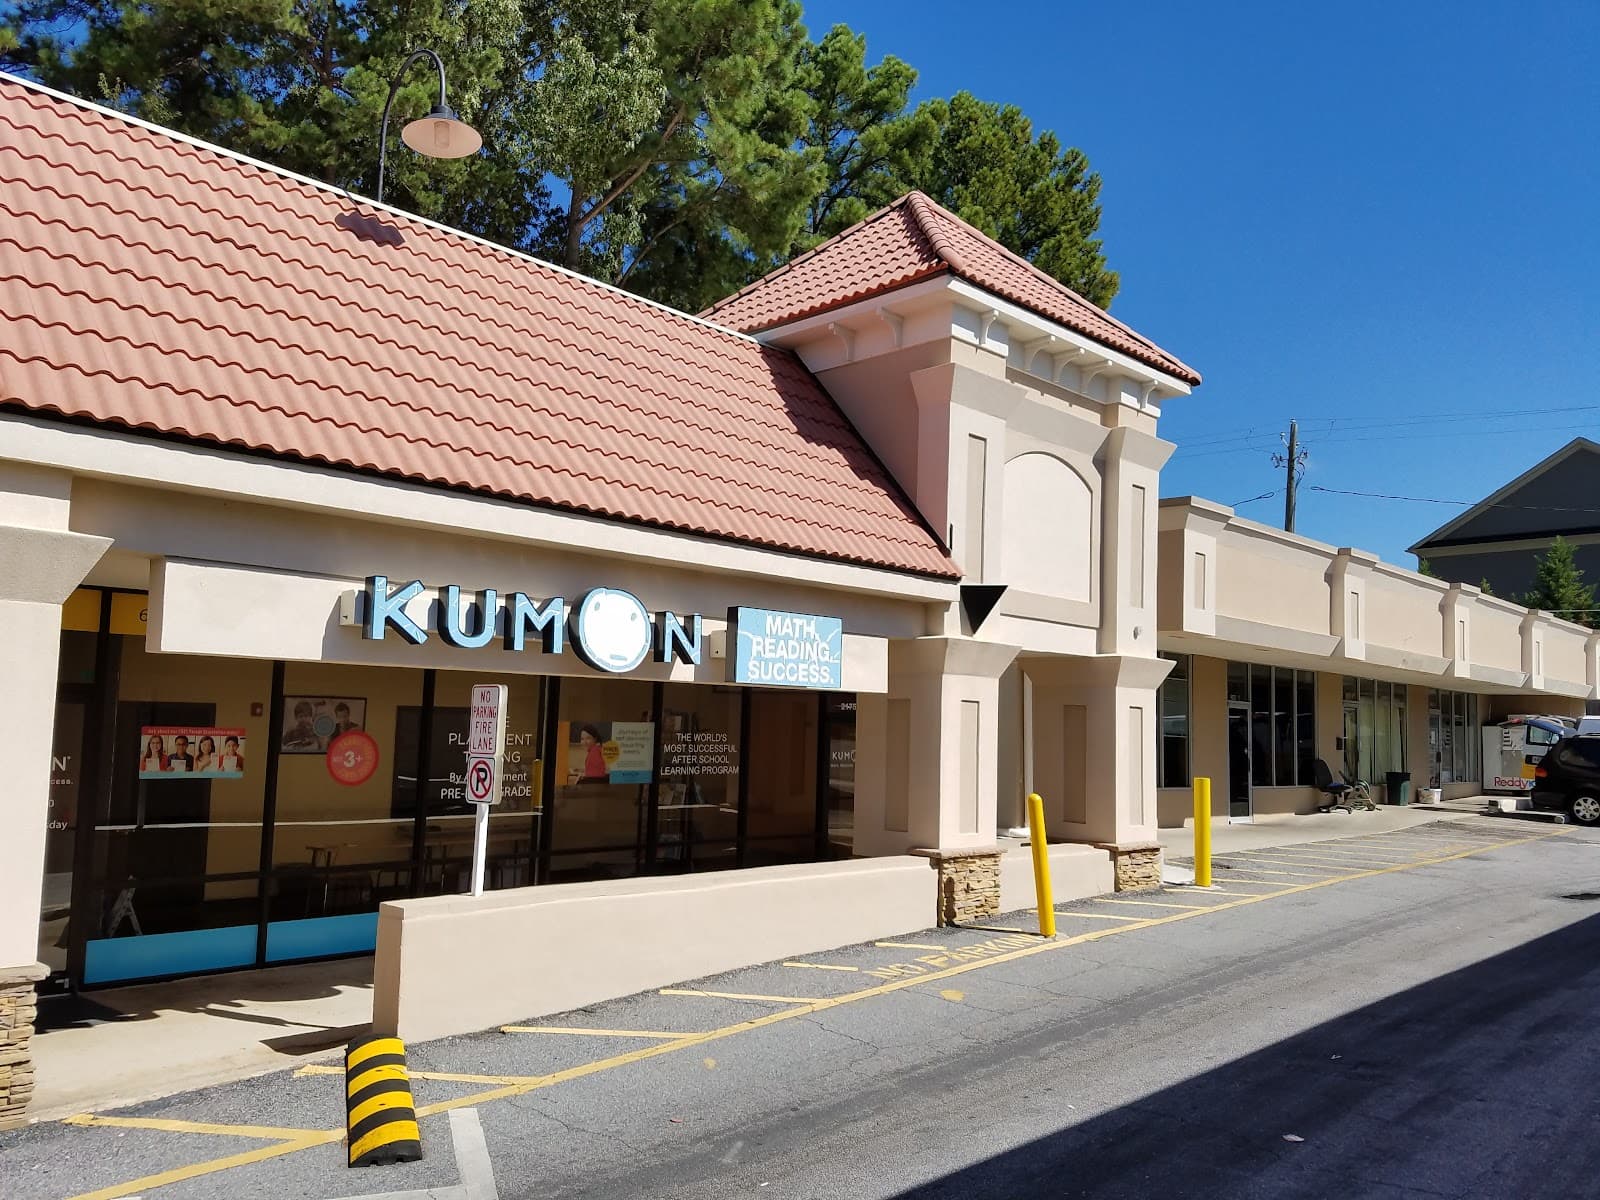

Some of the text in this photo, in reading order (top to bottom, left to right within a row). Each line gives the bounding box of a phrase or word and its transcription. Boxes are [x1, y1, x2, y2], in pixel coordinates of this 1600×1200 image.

[362, 575, 702, 673] KUMON
[480, 690, 491, 703] NO
[473, 705, 497, 719] PARKING
[475, 721, 493, 735] FIRE
[472, 737, 493, 750] LANE
[676, 733, 728, 742] THE WORLD'S
[664, 744, 737, 753] MOST SUCCESSFUL
[672, 755, 729, 764] AFTER SCHOOL
[660, 766, 739, 776] LEARNING PROGRAM
[1494, 776, 1526, 790] Reddy
